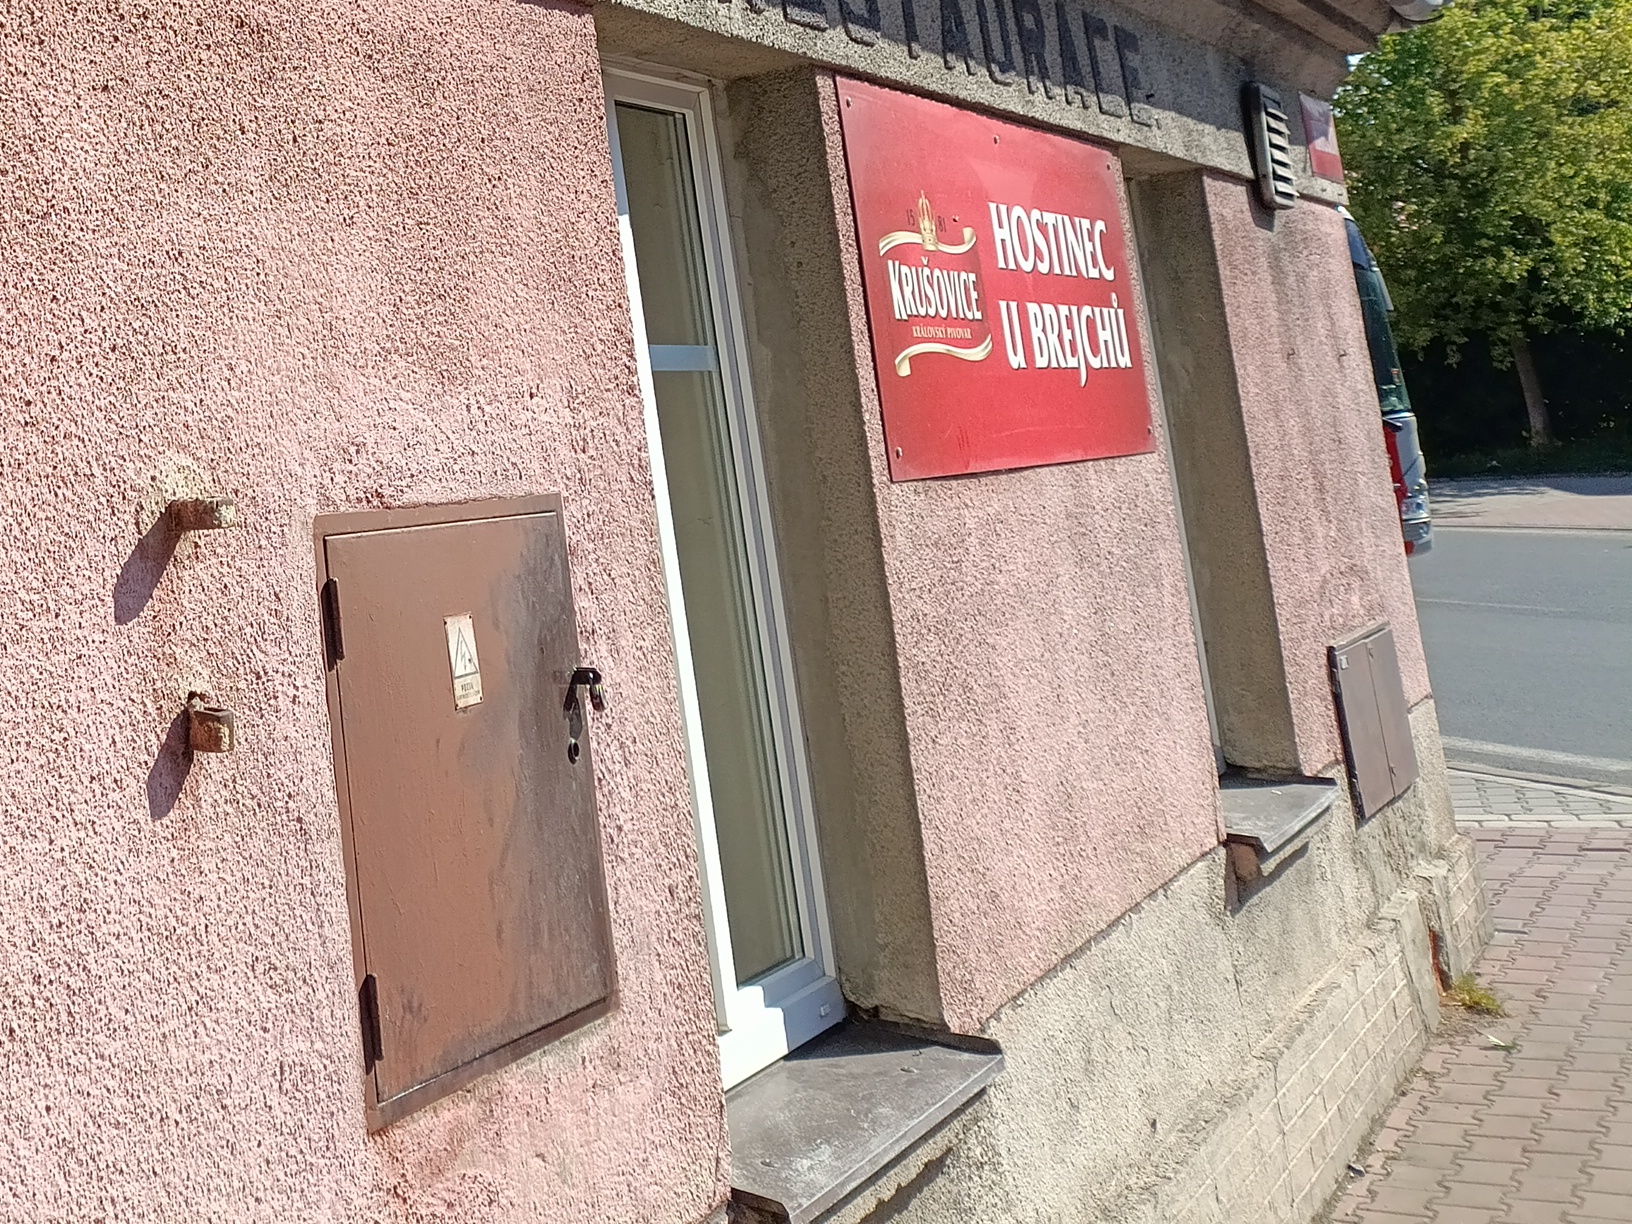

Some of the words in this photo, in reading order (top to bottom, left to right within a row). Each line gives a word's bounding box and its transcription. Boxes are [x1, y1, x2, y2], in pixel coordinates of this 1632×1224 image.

[988, 201, 1116, 282] HOSTINEC
[887, 256, 983, 321] KRUŠOVICE
[947, 327, 972, 340] PIVOVAR
[998, 299, 1028, 369] U
[1026, 292, 1133, 387] BREJCHŮ
